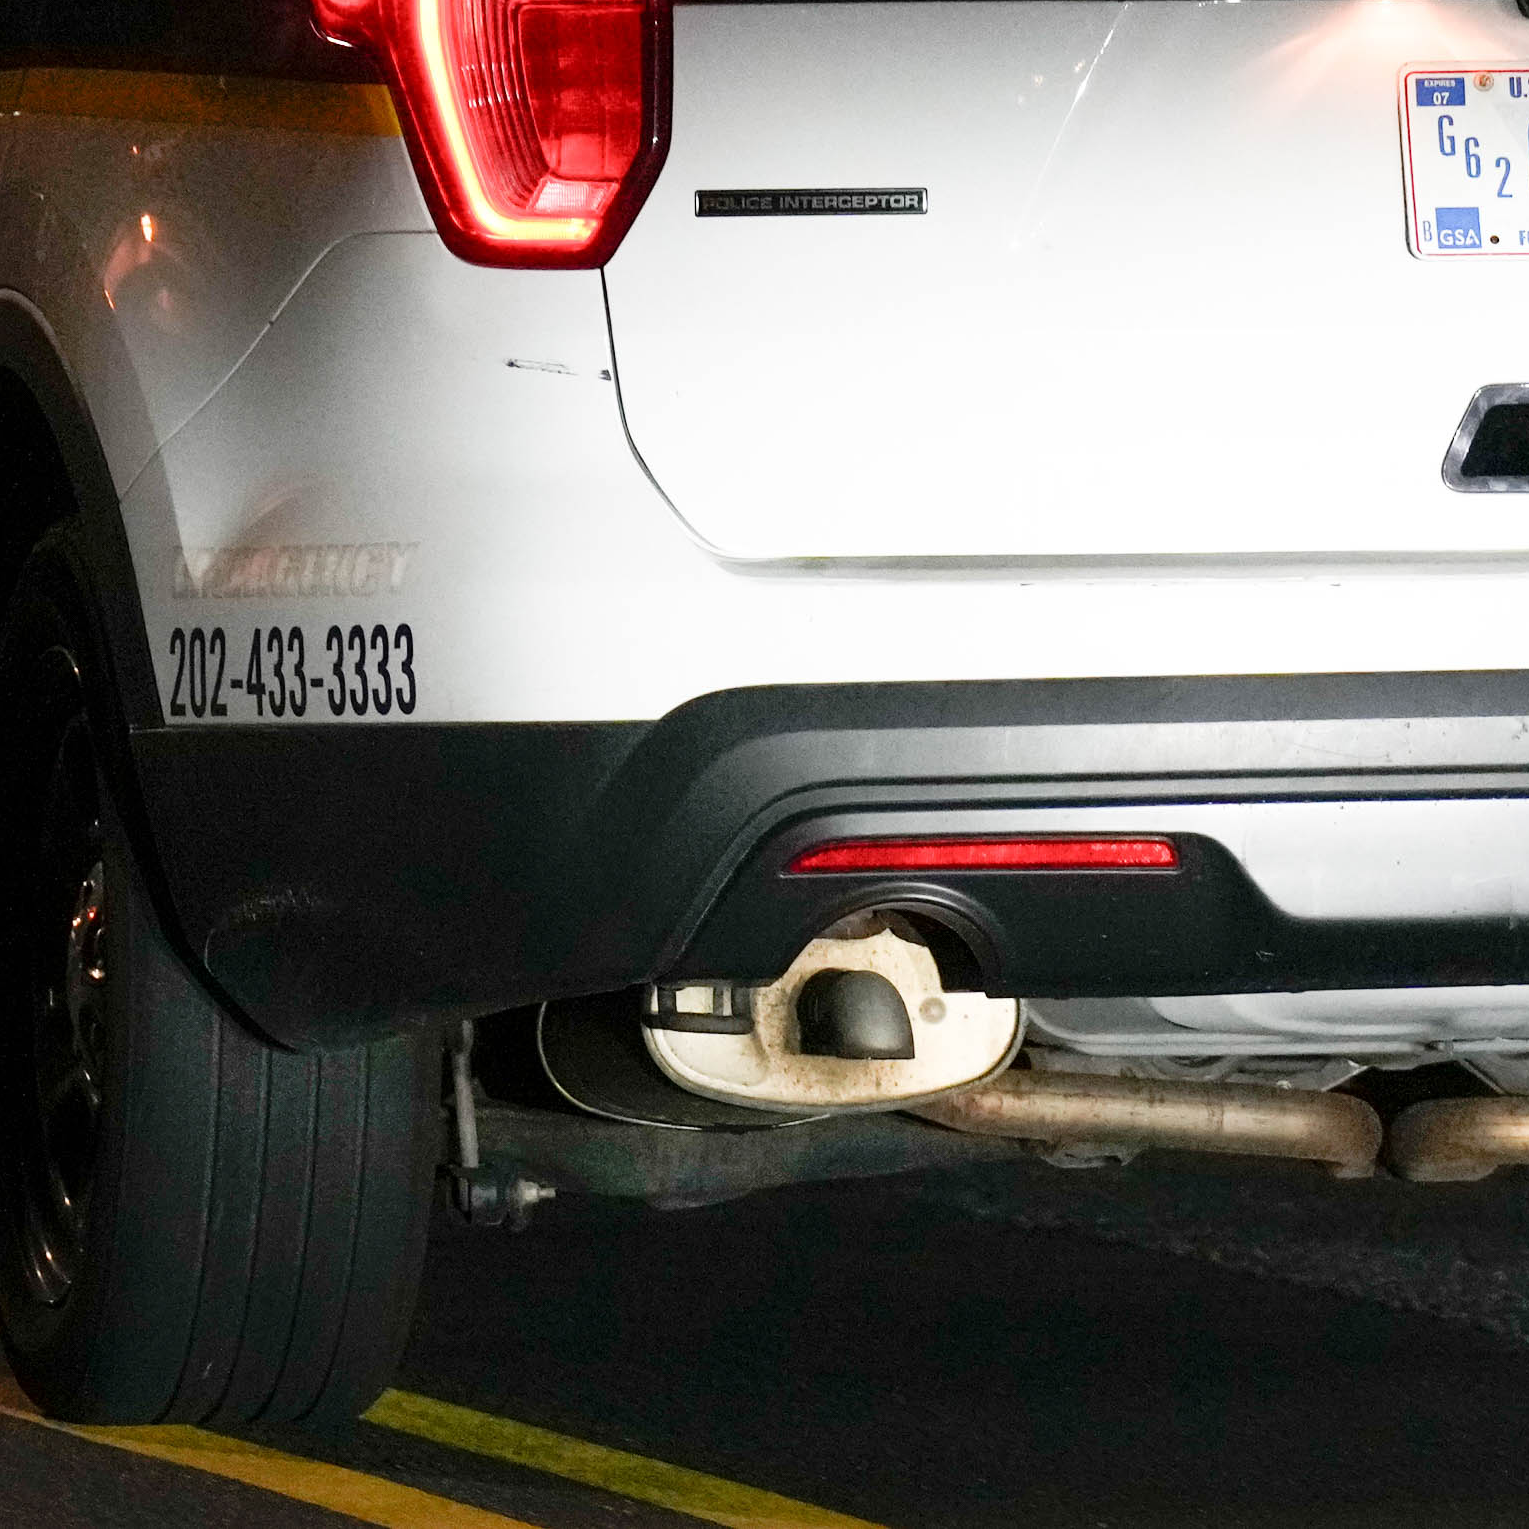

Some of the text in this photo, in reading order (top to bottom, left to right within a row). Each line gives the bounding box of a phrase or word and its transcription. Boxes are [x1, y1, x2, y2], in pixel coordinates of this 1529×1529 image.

[1433, 91, 1450, 105] 07
[702, 194, 920, 211] POLICE INTERCEPTOR
[1439, 228, 1481, 247] GSA
[170, 623, 416, 718] 202-433-3333
